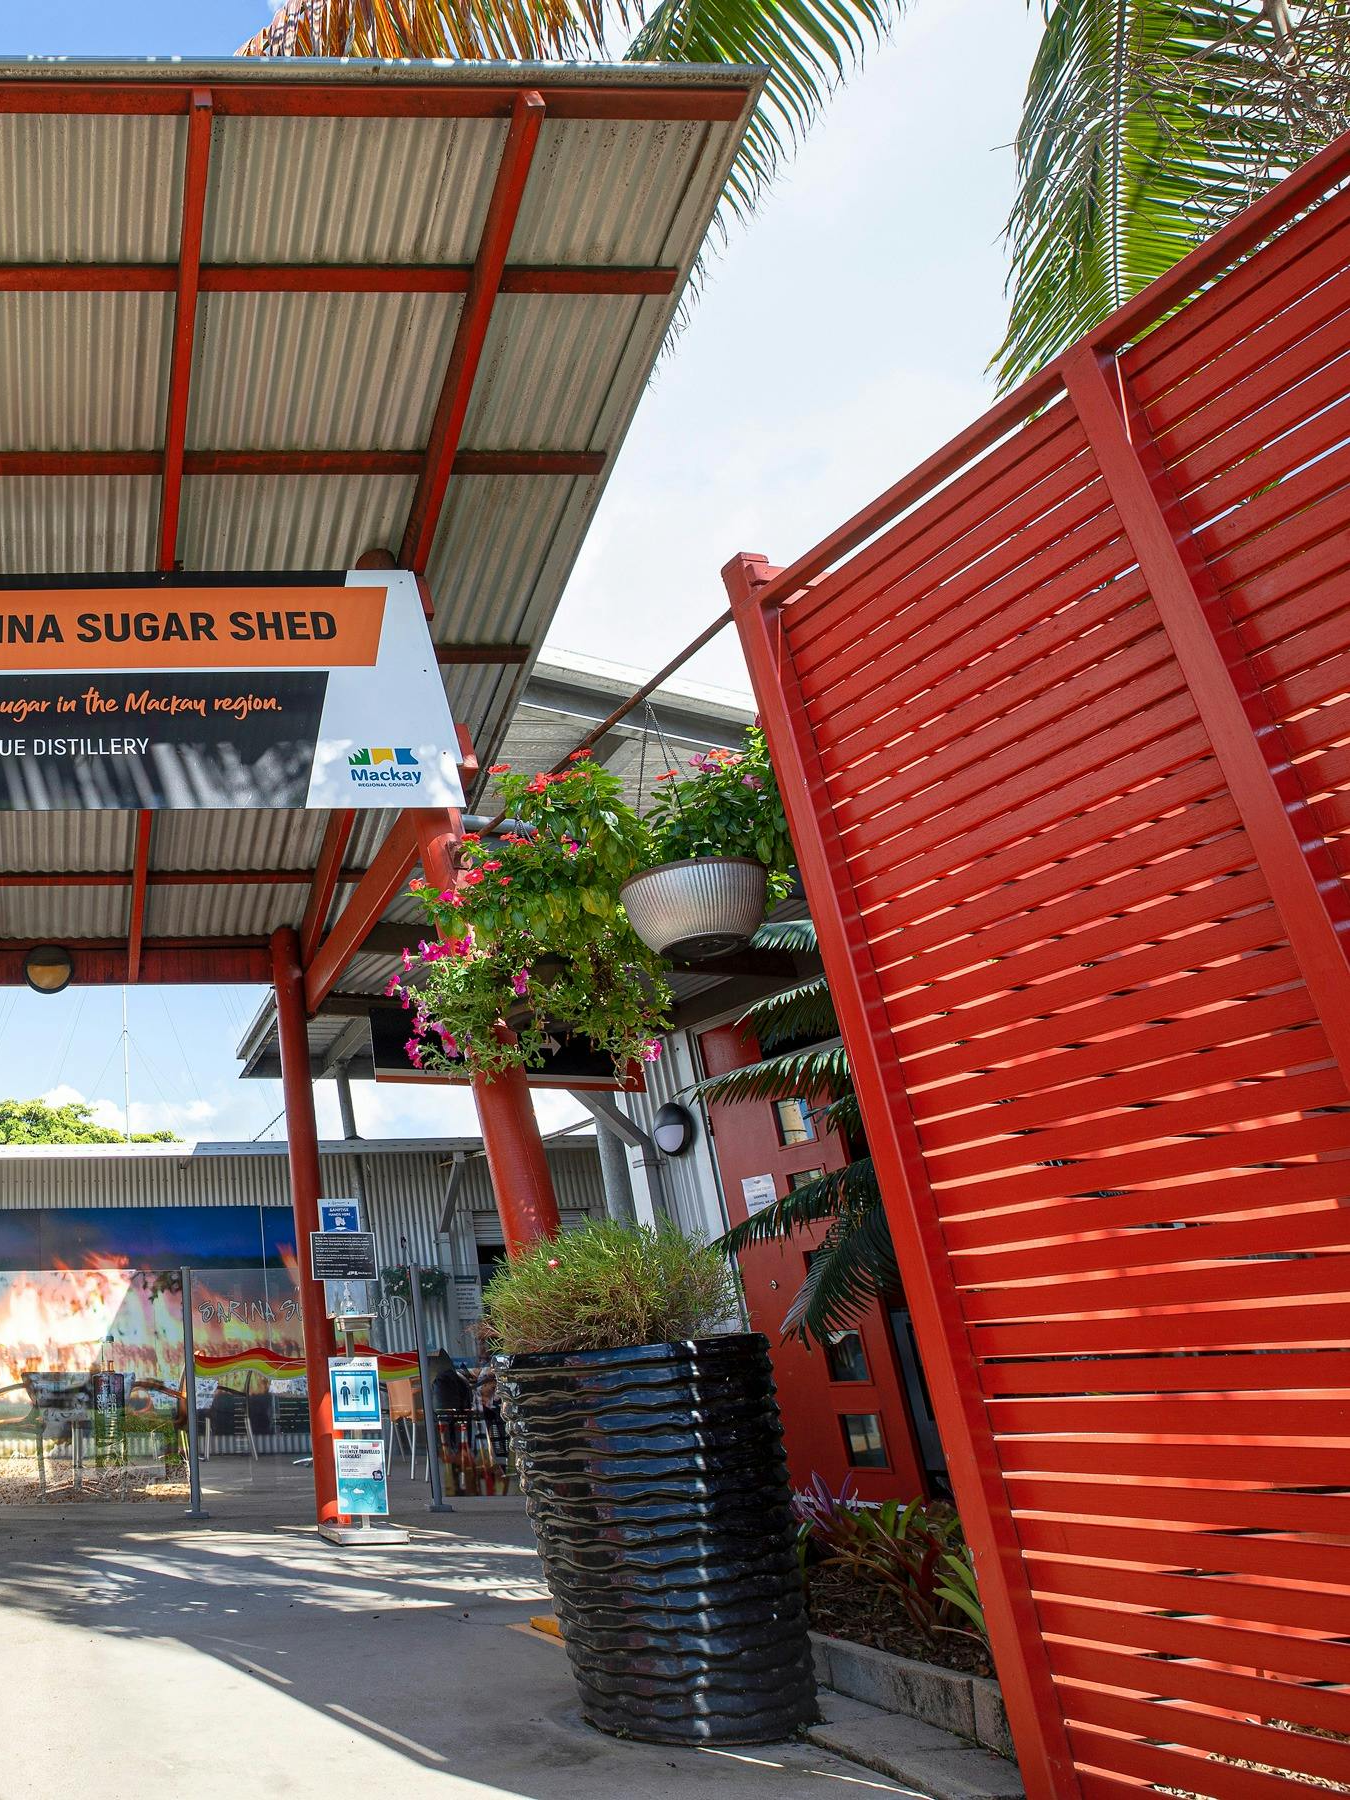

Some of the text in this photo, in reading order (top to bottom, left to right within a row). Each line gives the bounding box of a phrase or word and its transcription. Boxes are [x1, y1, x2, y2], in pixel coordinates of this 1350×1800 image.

[76, 611, 218, 643] SUGAR
[229, 611, 338, 641] SHED
[57, 694, 77, 713] in
[81, 686, 119, 715] the
[124, 690, 206, 717] Mackay
[213, 693, 283, 720] region.
[33, 737, 149, 756] DISTILLERY
[350, 766, 422, 785] Mackay
[198, 1299, 276, 1325] SARINA
